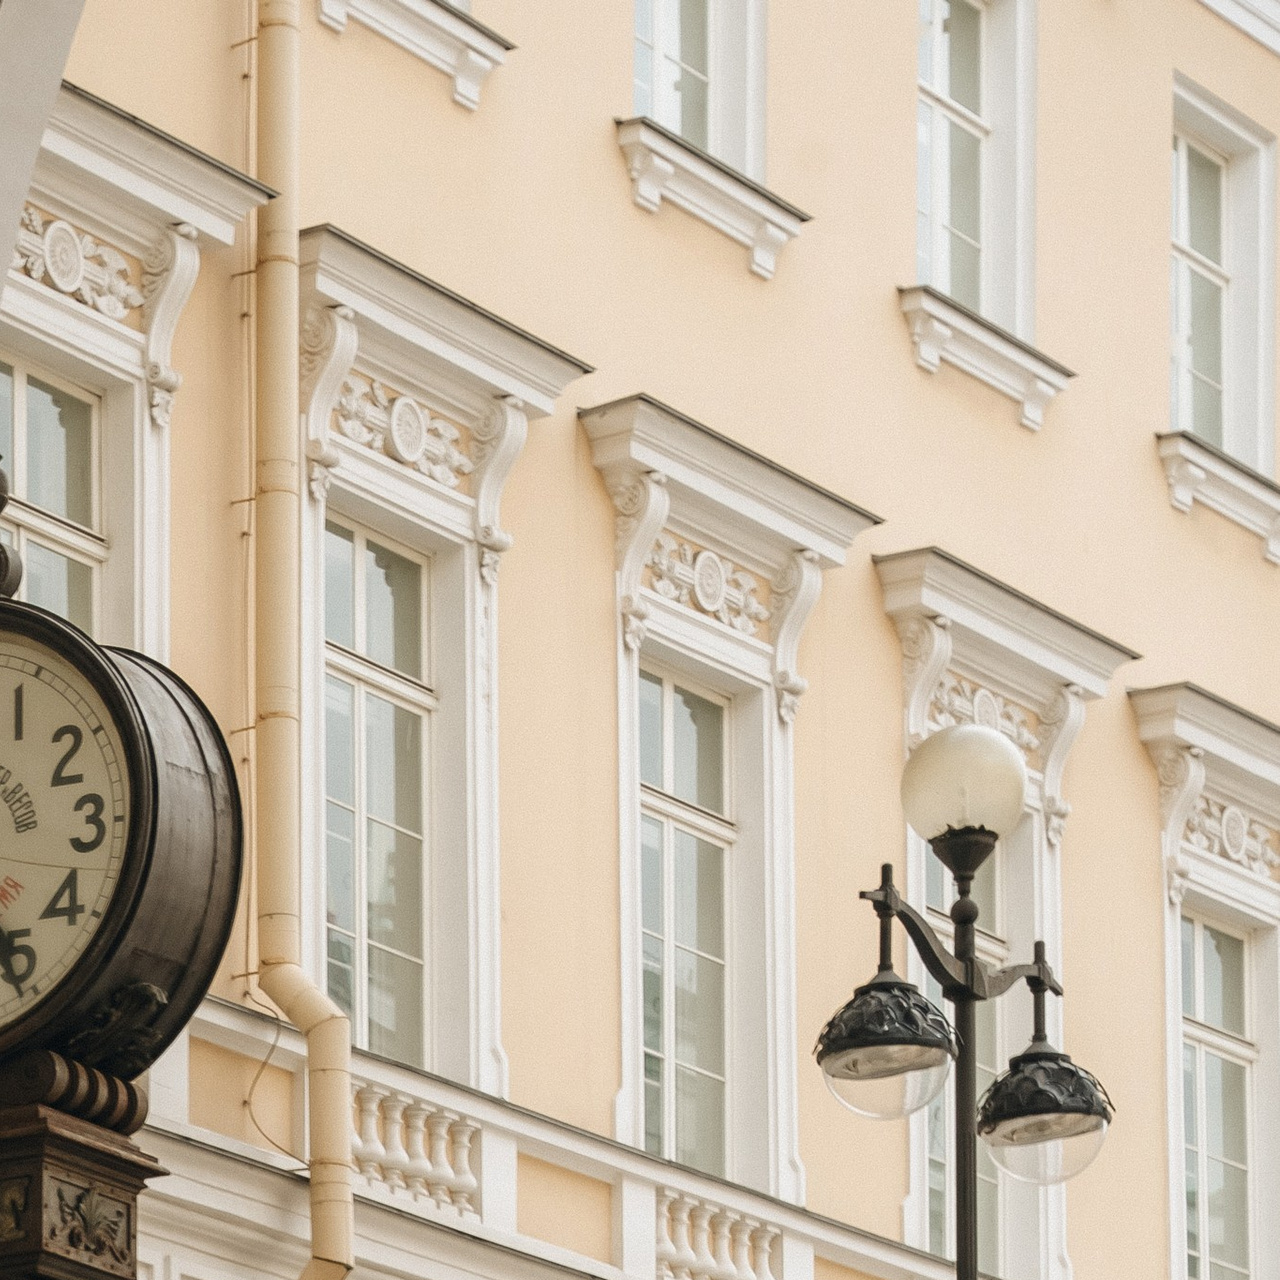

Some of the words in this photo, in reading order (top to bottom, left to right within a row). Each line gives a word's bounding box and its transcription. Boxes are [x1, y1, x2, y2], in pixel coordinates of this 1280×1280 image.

[14, 683, 23, 741] 1
[50, 724, 84, 787] 2
[5, 782, 38, 834] ВЕСОВ
[69, 793, 105, 853] 3
[39, 867, 85, 926] 4
[1, 928, 37, 986] 5
